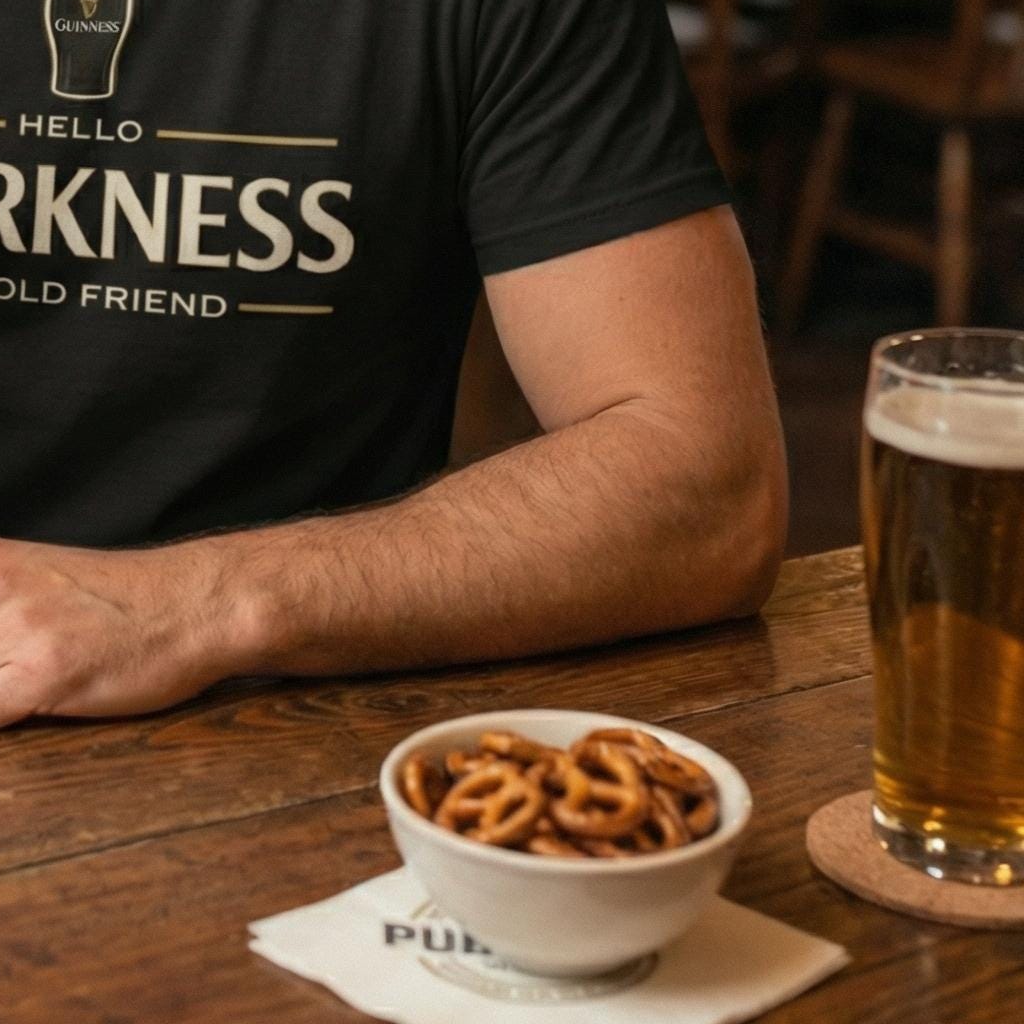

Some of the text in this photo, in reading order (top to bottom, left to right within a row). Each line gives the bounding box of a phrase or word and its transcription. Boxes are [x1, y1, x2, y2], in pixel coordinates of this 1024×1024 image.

[54, 17, 120, 33] GUINNESS
[19, 113, 143, 143] HELLO
[80, 283, 228, 318] FRIEND
